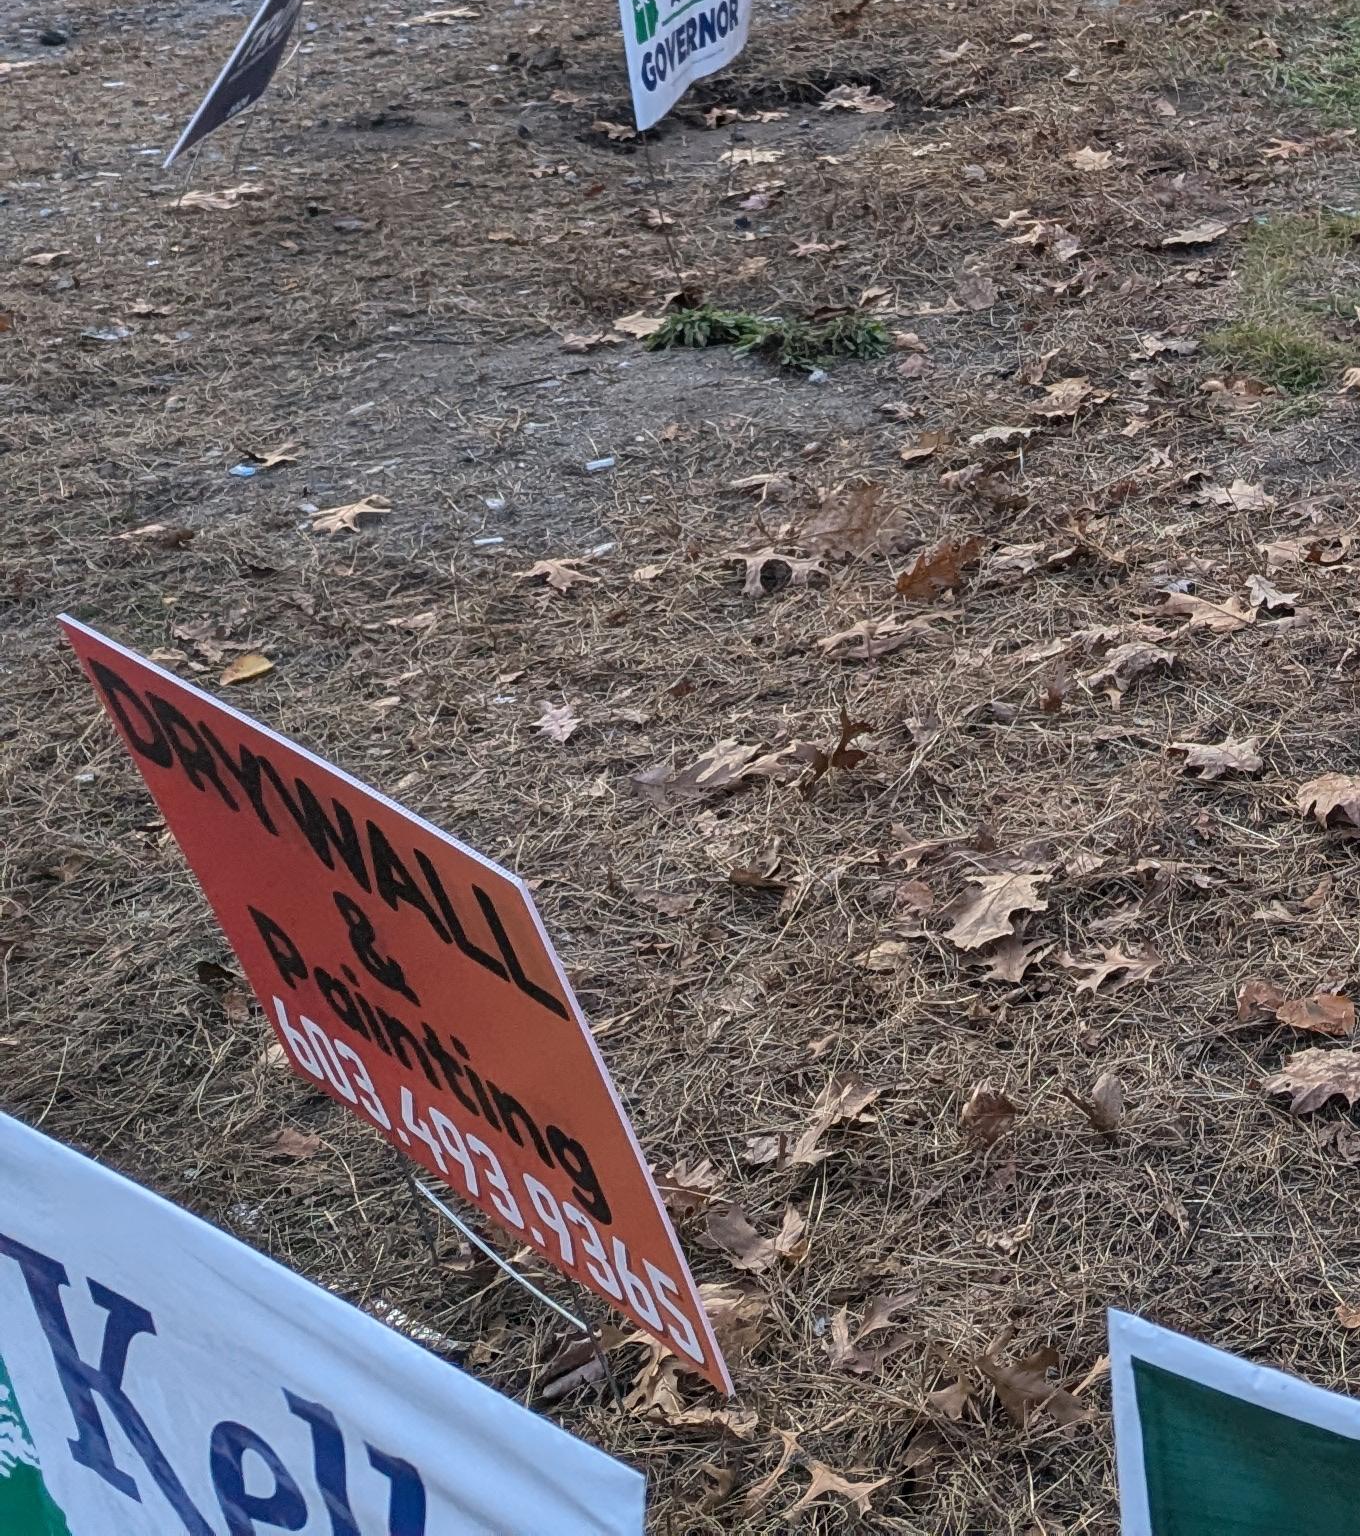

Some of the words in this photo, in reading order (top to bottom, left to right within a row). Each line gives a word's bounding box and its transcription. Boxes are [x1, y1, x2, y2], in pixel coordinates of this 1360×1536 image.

[89, 659, 570, 1020] DRYWALL
[333, 891, 419, 1005] &
[247, 906, 612, 1224] Painting
